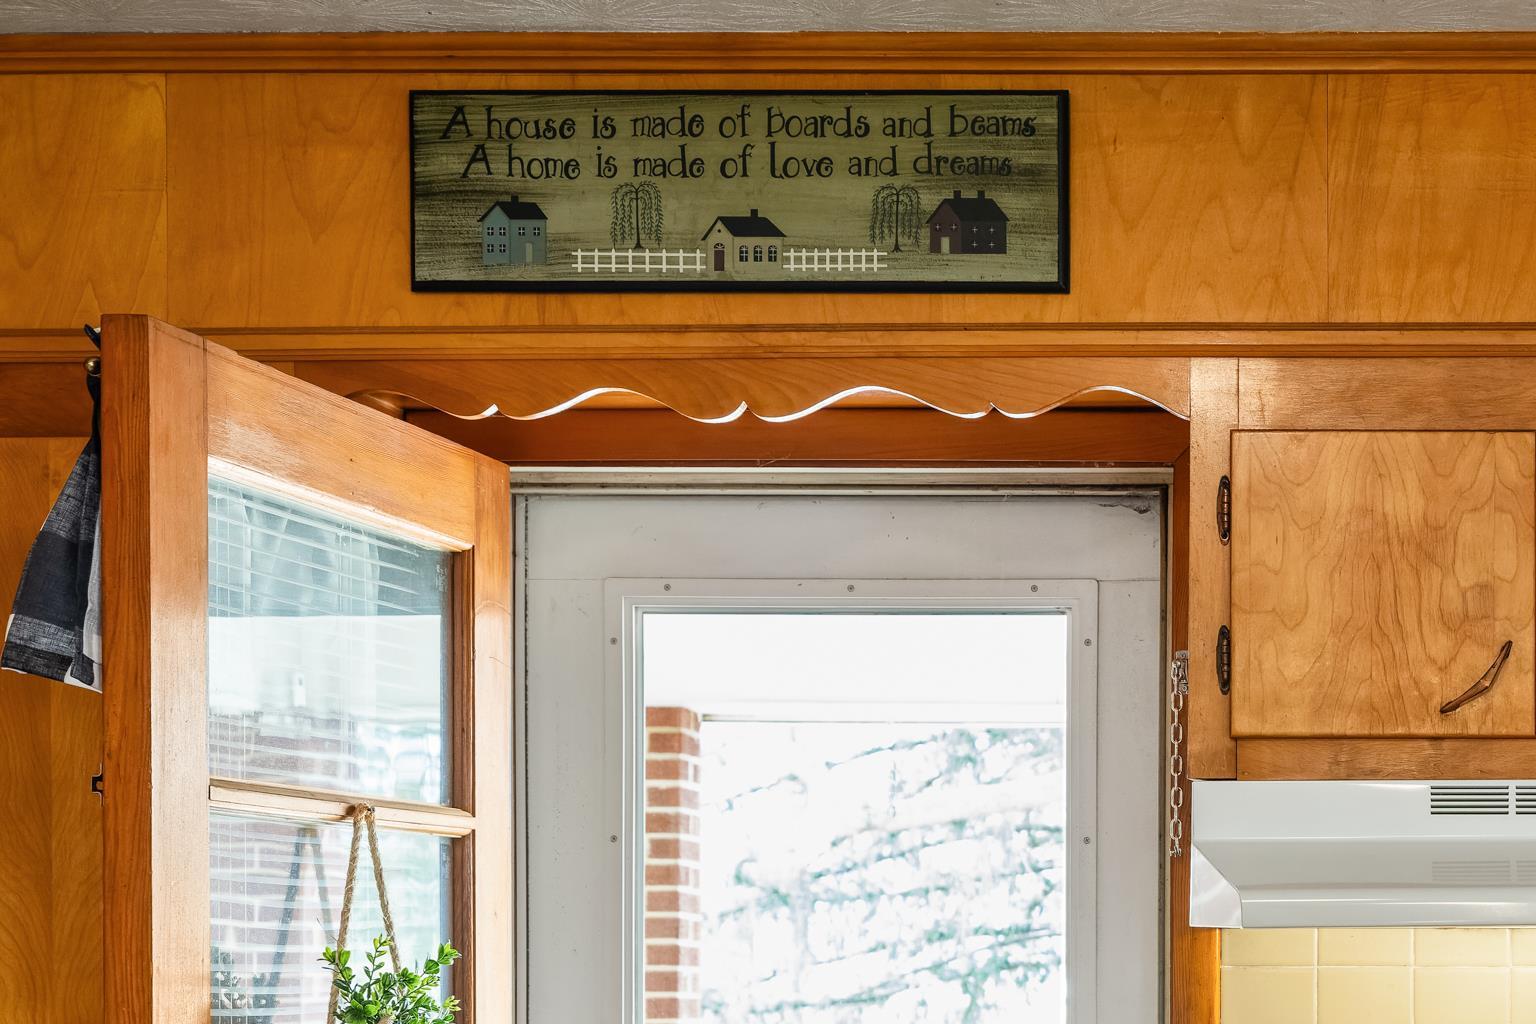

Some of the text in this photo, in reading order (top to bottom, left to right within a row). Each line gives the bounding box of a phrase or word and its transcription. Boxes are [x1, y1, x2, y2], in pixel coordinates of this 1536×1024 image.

[439, 103, 1038, 140] A house is made of boards and beams
[460, 140, 1014, 180] A home is made of love and dreams
